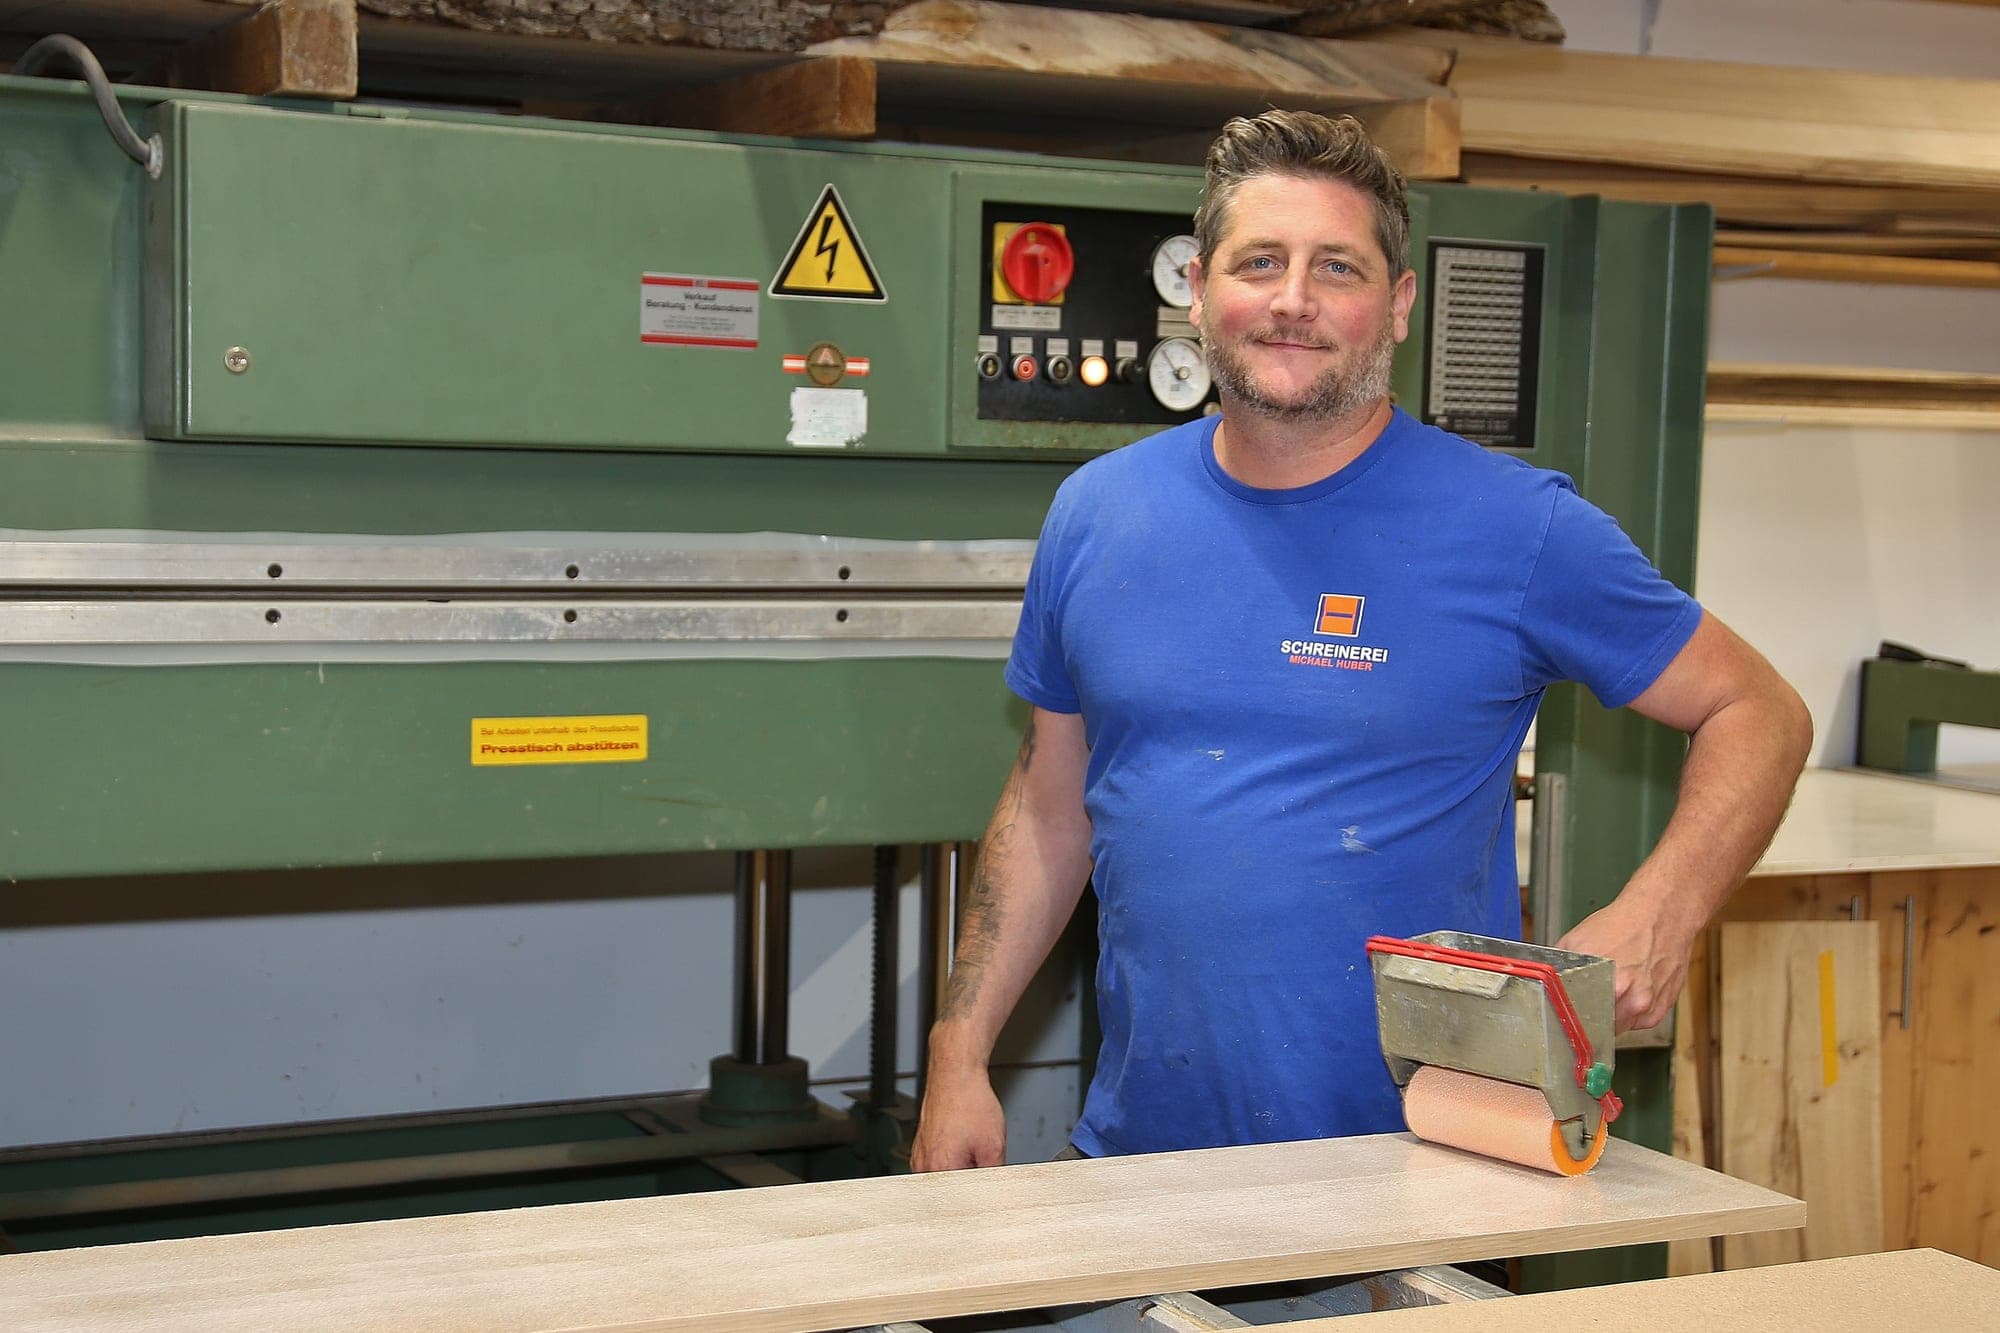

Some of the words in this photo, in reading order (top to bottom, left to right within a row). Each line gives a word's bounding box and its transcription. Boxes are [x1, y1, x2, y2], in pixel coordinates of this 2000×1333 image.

[684, 291, 717, 301] Verkauf
[646, 299, 686, 310] Beratung
[694, 302, 753, 313] Kundendienst
[1280, 640, 1389, 663] SCHREINEREI
[1289, 655, 1333, 667] MICHAEL
[1336, 659, 1373, 671] HUBER
[497, 727, 531, 735] Arbeiten
[481, 742, 563, 753] Presstisch
[567, 740, 640, 752] abstützen
